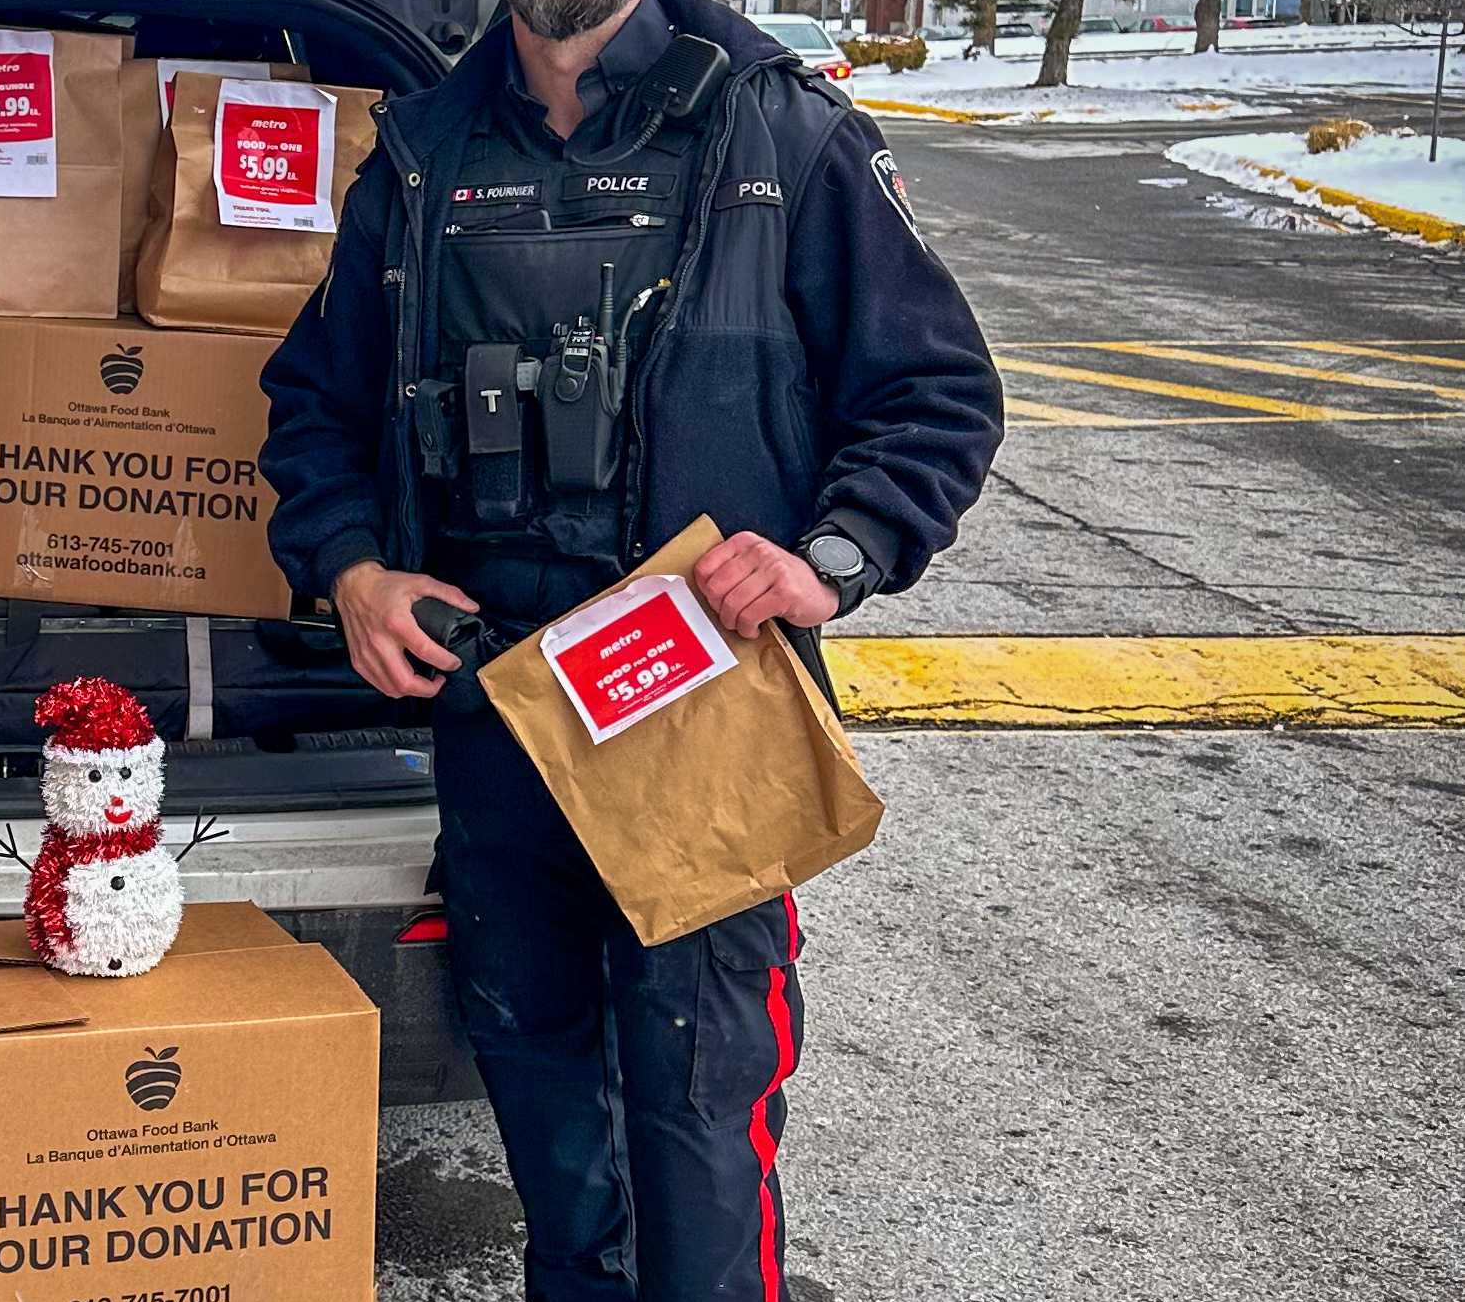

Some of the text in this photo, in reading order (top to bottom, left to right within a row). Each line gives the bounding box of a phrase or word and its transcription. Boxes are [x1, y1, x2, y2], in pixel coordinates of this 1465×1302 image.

[0, 82, 35, 91] BUNDLE
[251, 119, 287, 130] metro
[237, 140, 266, 150] FOOD
[279, 142, 303, 153] ONE
[239, 154, 288, 181] $5.99
[475, 185, 535, 199] S. FOURNIER
[587, 176, 649, 191] POLICE
[738, 181, 783, 201] POLI
[68, 401, 171, 418] Ottawa Food Bank
[480, 389, 502, 413] T
[22, 412, 216, 436] La Banque d'Alimentation d'Ottawa
[102, 450, 173, 481] YOU
[184, 456, 257, 487] FOR
[78, 483, 258, 522] DONATION
[47, 533, 174, 558] 613-745-7001
[16, 551, 206, 580] ottawafoodbank.ca
[600, 629, 642, 659] metro
[596, 663, 632, 689] FOOD
[646, 639, 675, 658] ONE
[607, 661, 670, 701] $5.99
[86, 1119, 219, 1142] Ottawa Food Bank
[26, 1132, 277, 1164] La Banque d'Alimentation d'Ottawa
[135, 1176, 225, 1216] YOU
[240, 1165, 329, 1206] FOR
[106, 1209, 332, 1263] DONATION
